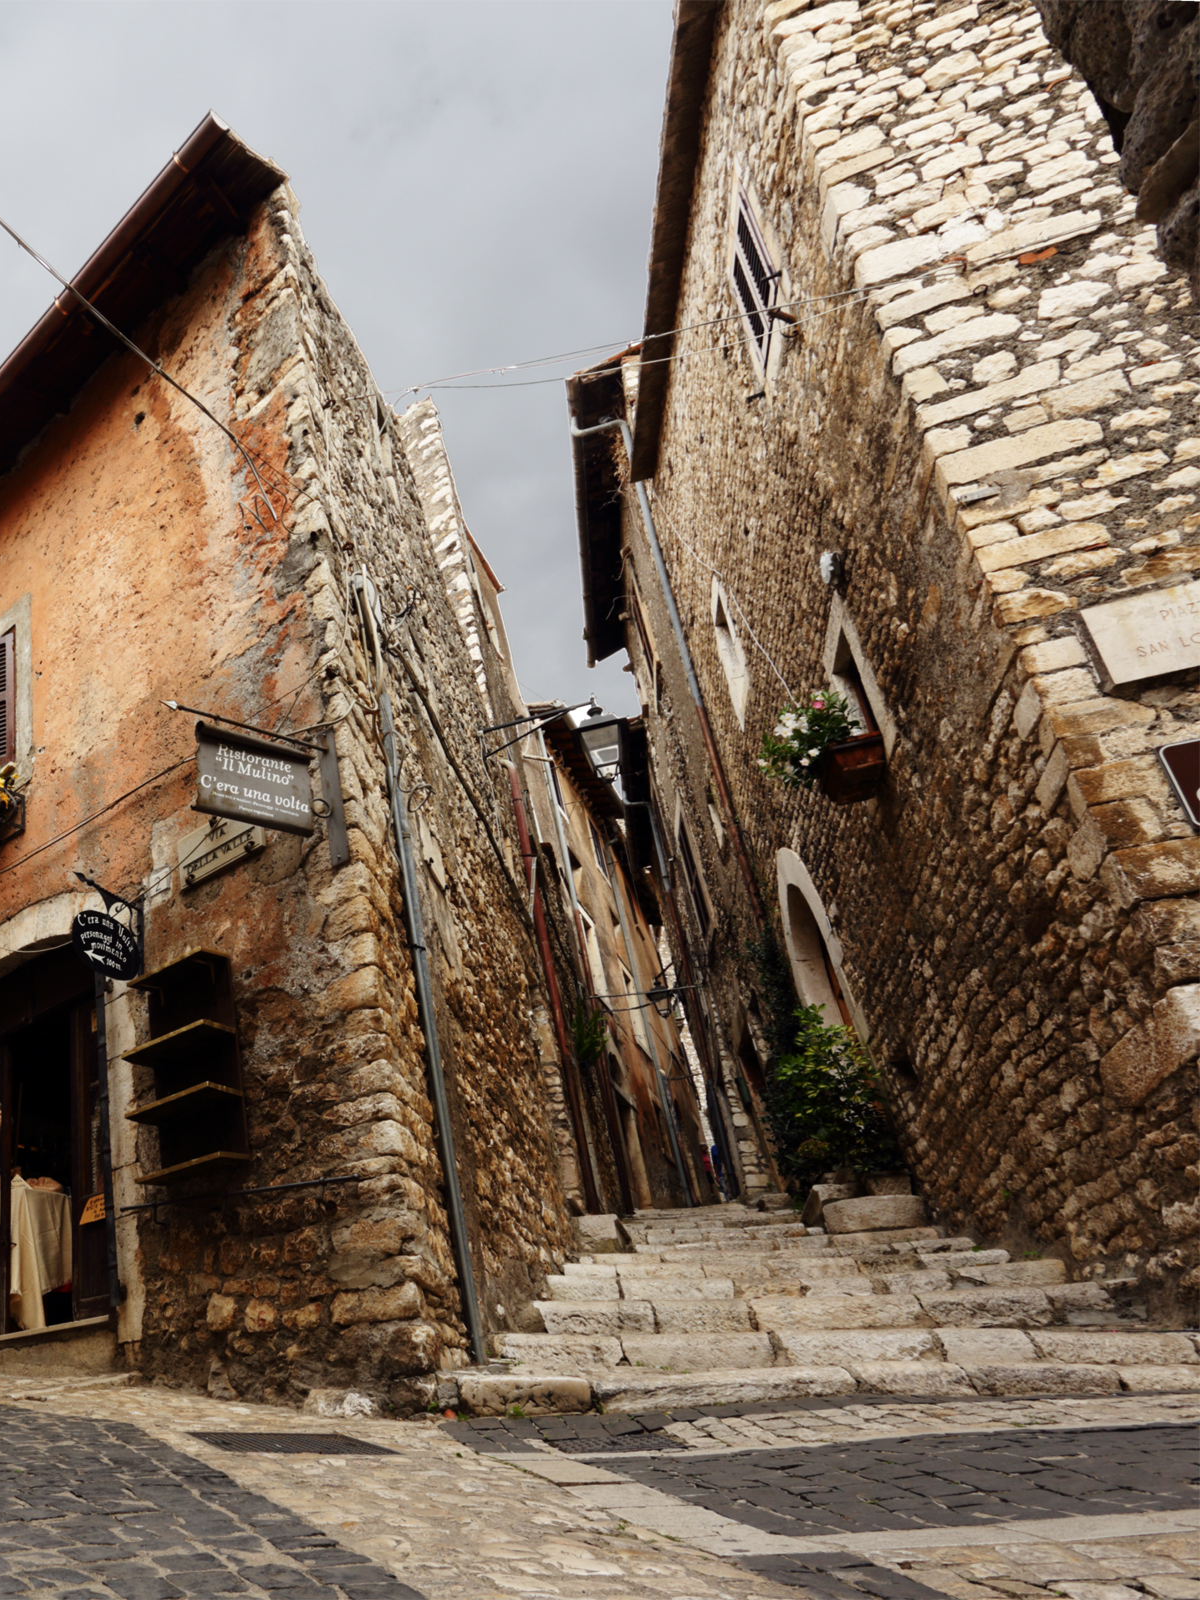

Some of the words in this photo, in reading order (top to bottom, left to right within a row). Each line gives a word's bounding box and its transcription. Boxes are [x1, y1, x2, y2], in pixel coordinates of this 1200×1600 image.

[1159, 601, 1200, 621] PIAZ
[1136, 640, 1170, 657] SAN
[217, 743, 292, 773] Ristorante
[200, 774, 240, 795] C'era
[243, 787, 271, 803] una
[275, 796, 310, 813] volta
[208, 827, 226, 842] VIA
[187, 851, 218, 875] DELLA
[220, 831, 253, 855] VALLE
[155, 876, 162, 892] 2
[77, 913, 99, 927] C'era
[102, 918, 114, 930] una
[80, 931, 113, 945] personaggi
[115, 940, 123, 951] in
[90, 942, 127, 963] movimento
